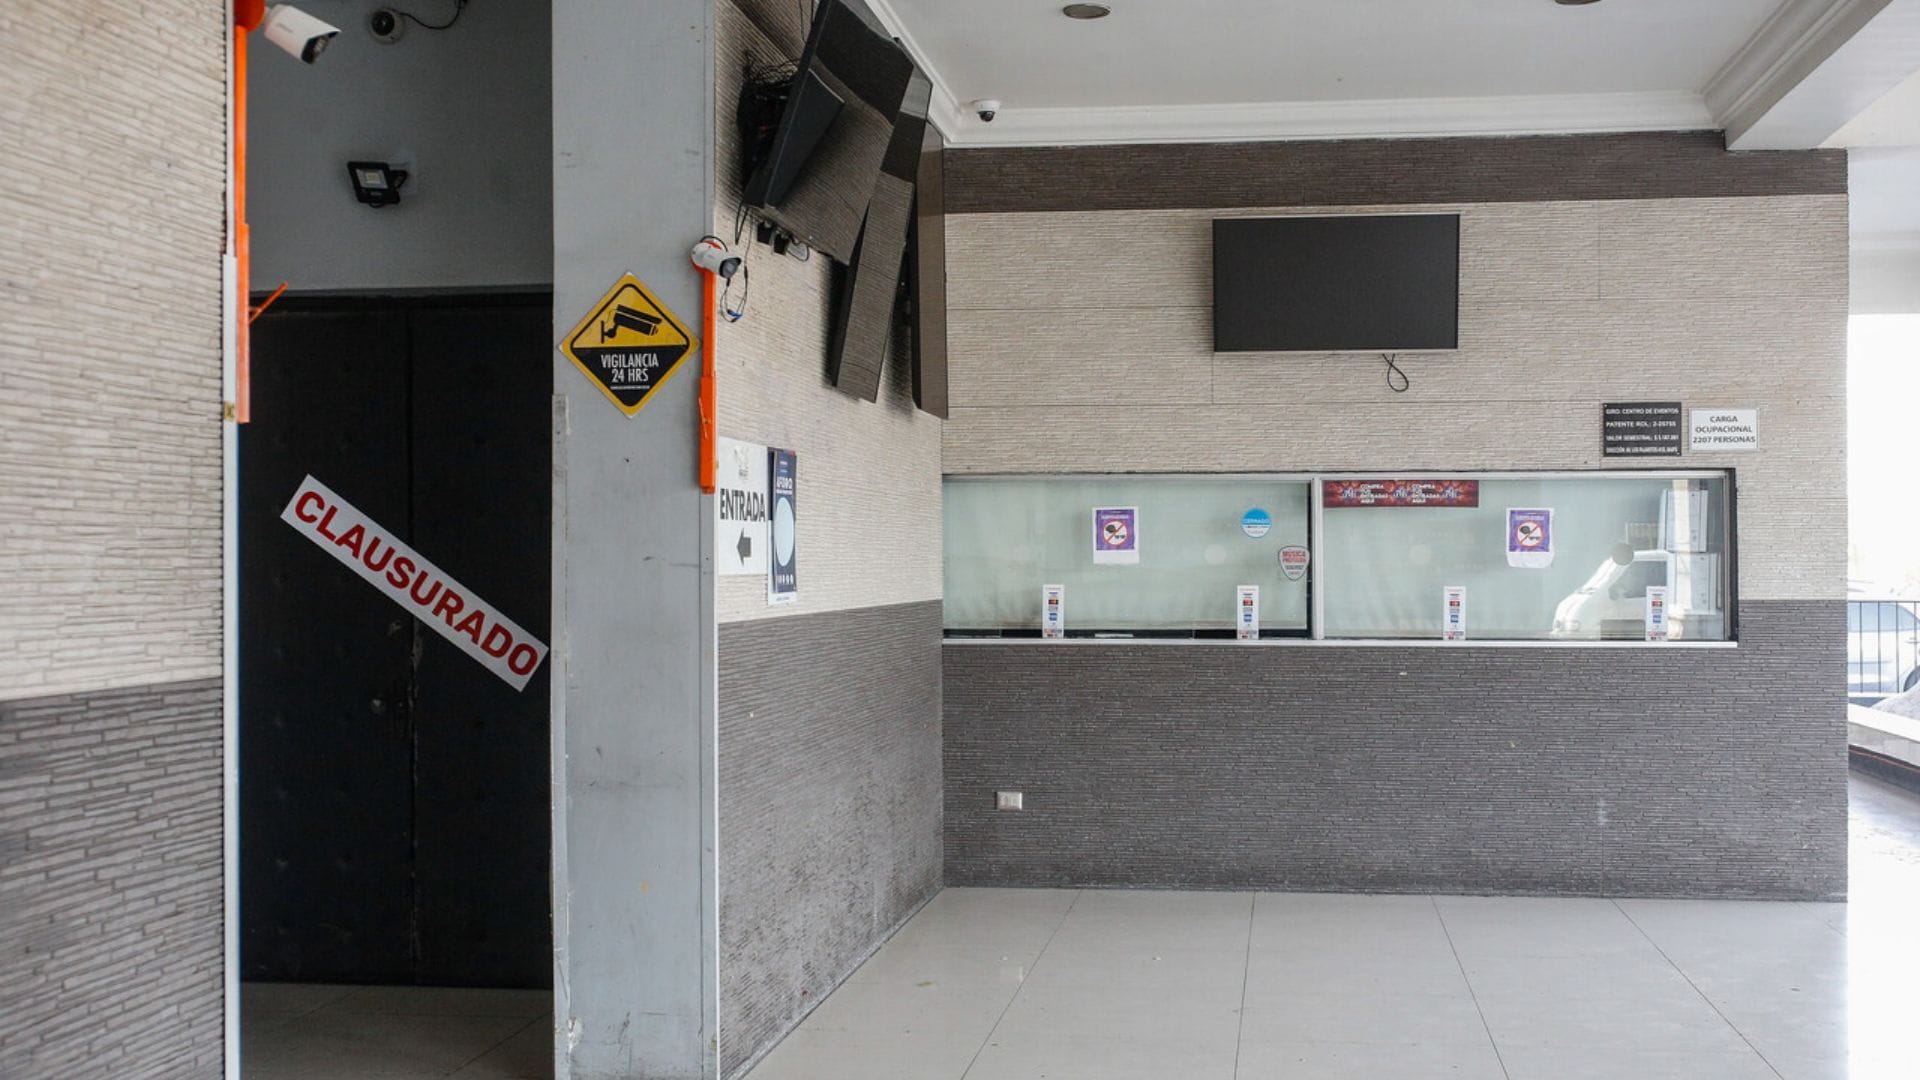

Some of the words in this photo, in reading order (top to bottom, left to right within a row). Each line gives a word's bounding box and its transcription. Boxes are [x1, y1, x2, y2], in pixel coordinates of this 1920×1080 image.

[600, 353, 659, 368] VIGILANCIA
[611, 368, 625, 383] 24
[628, 368, 649, 382] HRS
[1709, 415, 1738, 423] CARGA
[1694, 425, 1753, 434] OCUPACIONAL
[1692, 435, 1712, 444] 2207
[1713, 435, 1756, 443] PERSONAS
[720, 488, 766, 522] ENTRADA
[295, 491, 538, 676] CLAUSURADO
